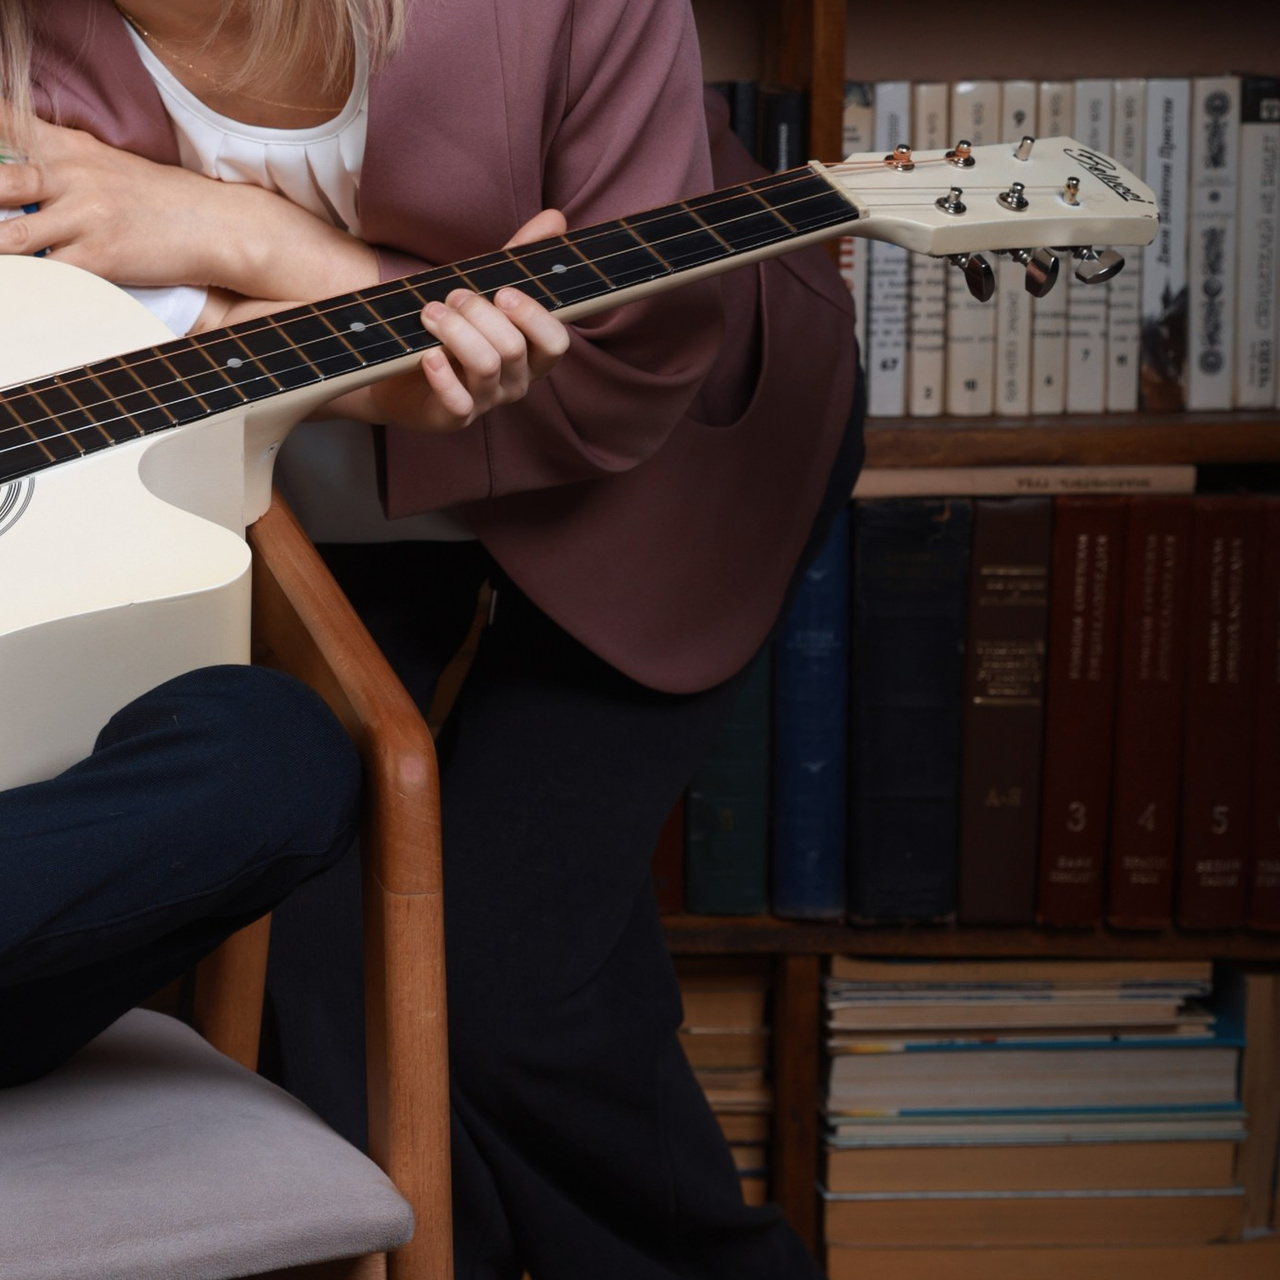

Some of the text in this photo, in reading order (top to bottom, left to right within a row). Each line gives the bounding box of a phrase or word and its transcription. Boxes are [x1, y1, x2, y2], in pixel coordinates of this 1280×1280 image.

[1065, 800, 1087, 833] 3
[1137, 802, 1158, 832] 4
[1210, 806, 1230, 836] 5
